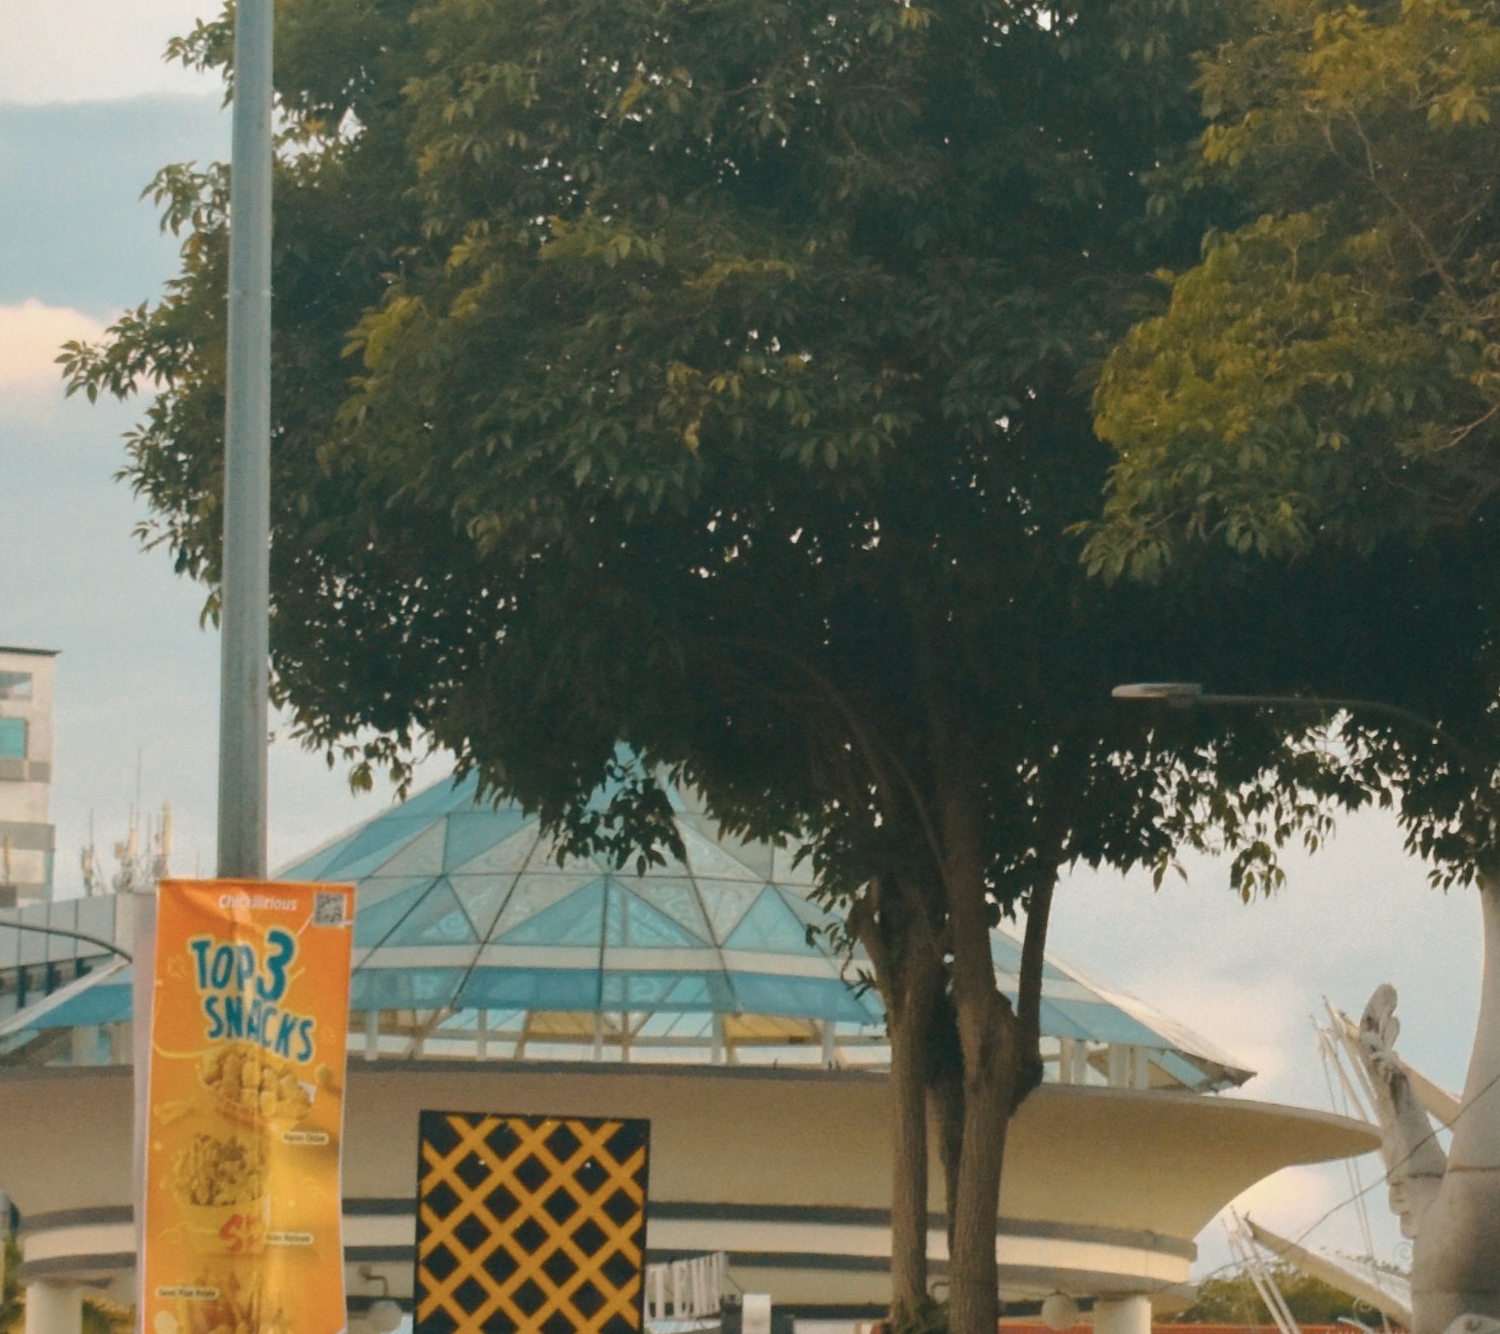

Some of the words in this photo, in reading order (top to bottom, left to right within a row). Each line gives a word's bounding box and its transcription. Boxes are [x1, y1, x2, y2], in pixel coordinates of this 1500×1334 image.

[191, 939, 256, 992] TOP
[256, 929, 296, 1001] 3
[204, 995, 315, 1063] SNACKS
